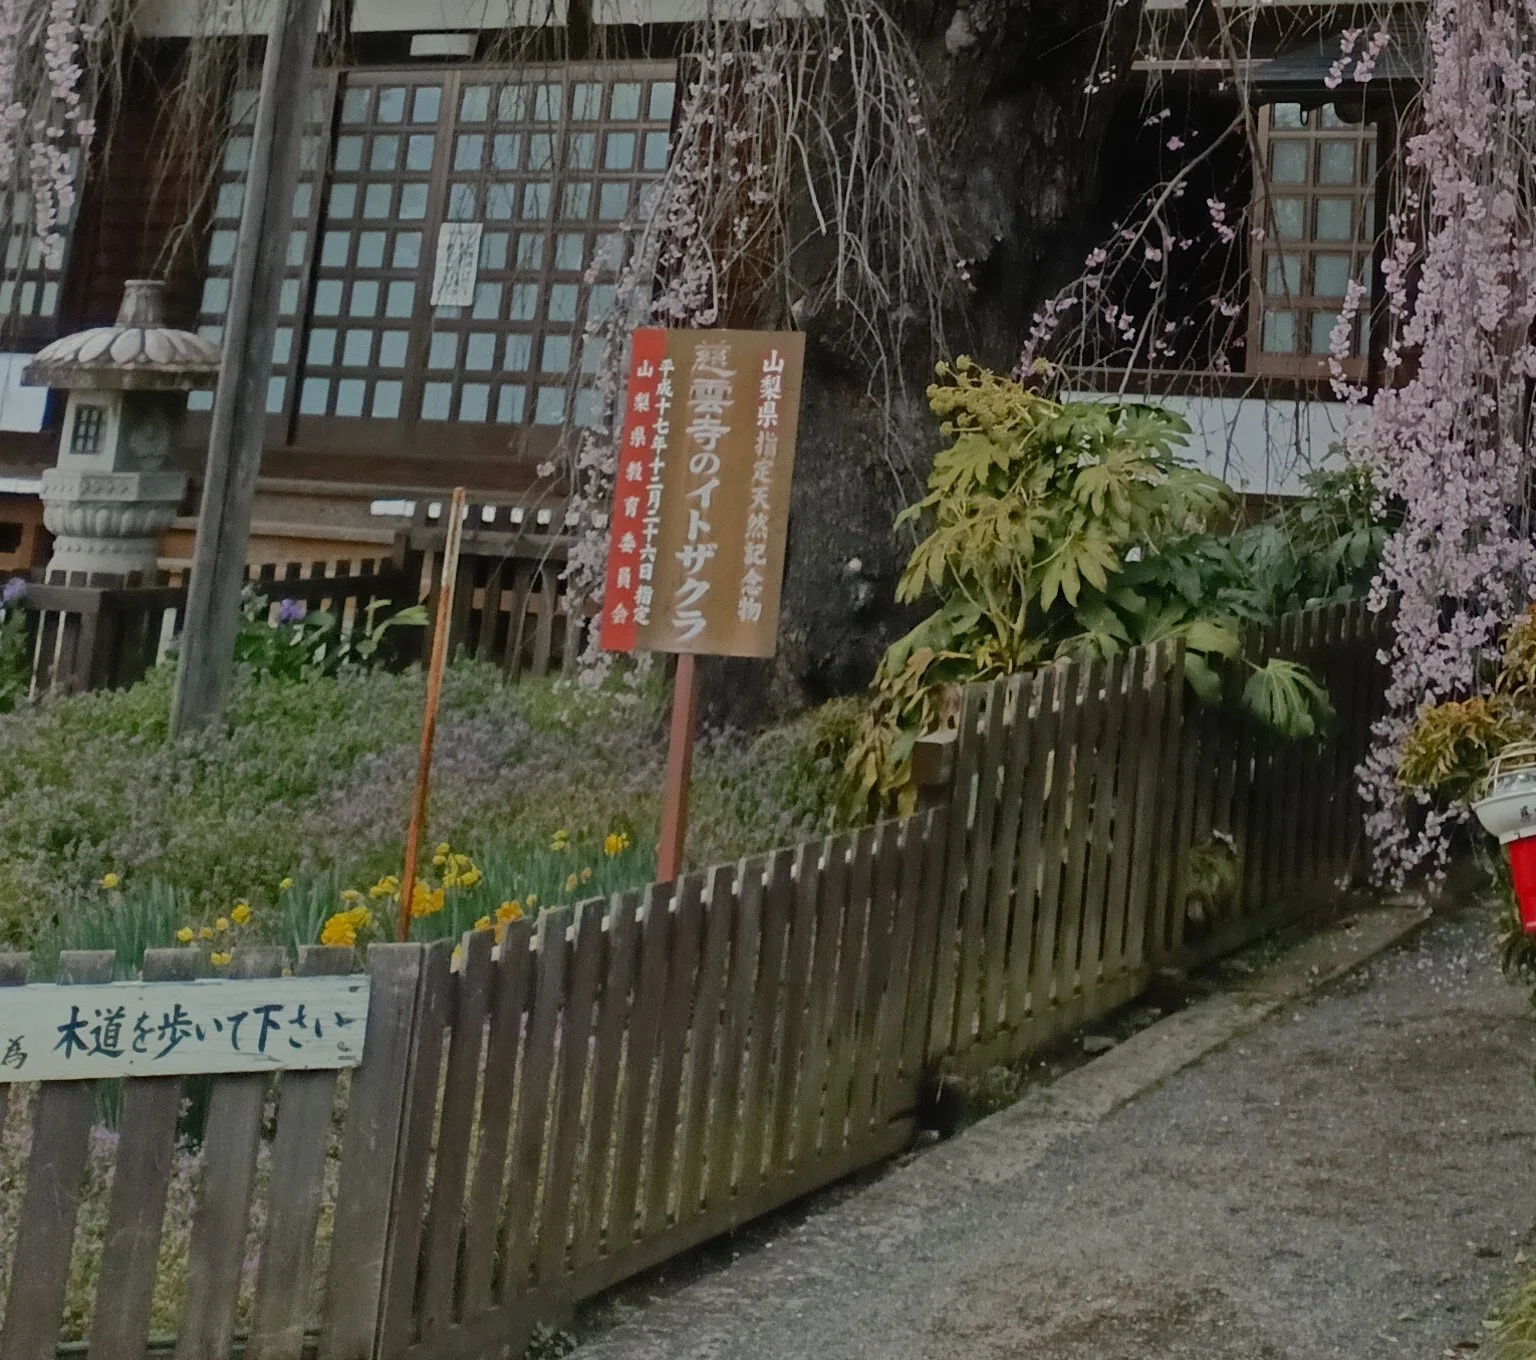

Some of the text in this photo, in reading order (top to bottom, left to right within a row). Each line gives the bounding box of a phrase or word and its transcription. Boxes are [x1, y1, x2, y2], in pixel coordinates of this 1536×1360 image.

[610, 359, 654, 625] 山梨県教育委員会
[672, 340, 738, 643] 慈雲寺のイトザクラ
[737, 348, 785, 624] 山梨県指定天然記念物
[53, 1003, 357, 1060] 木道を歩いて下さい
